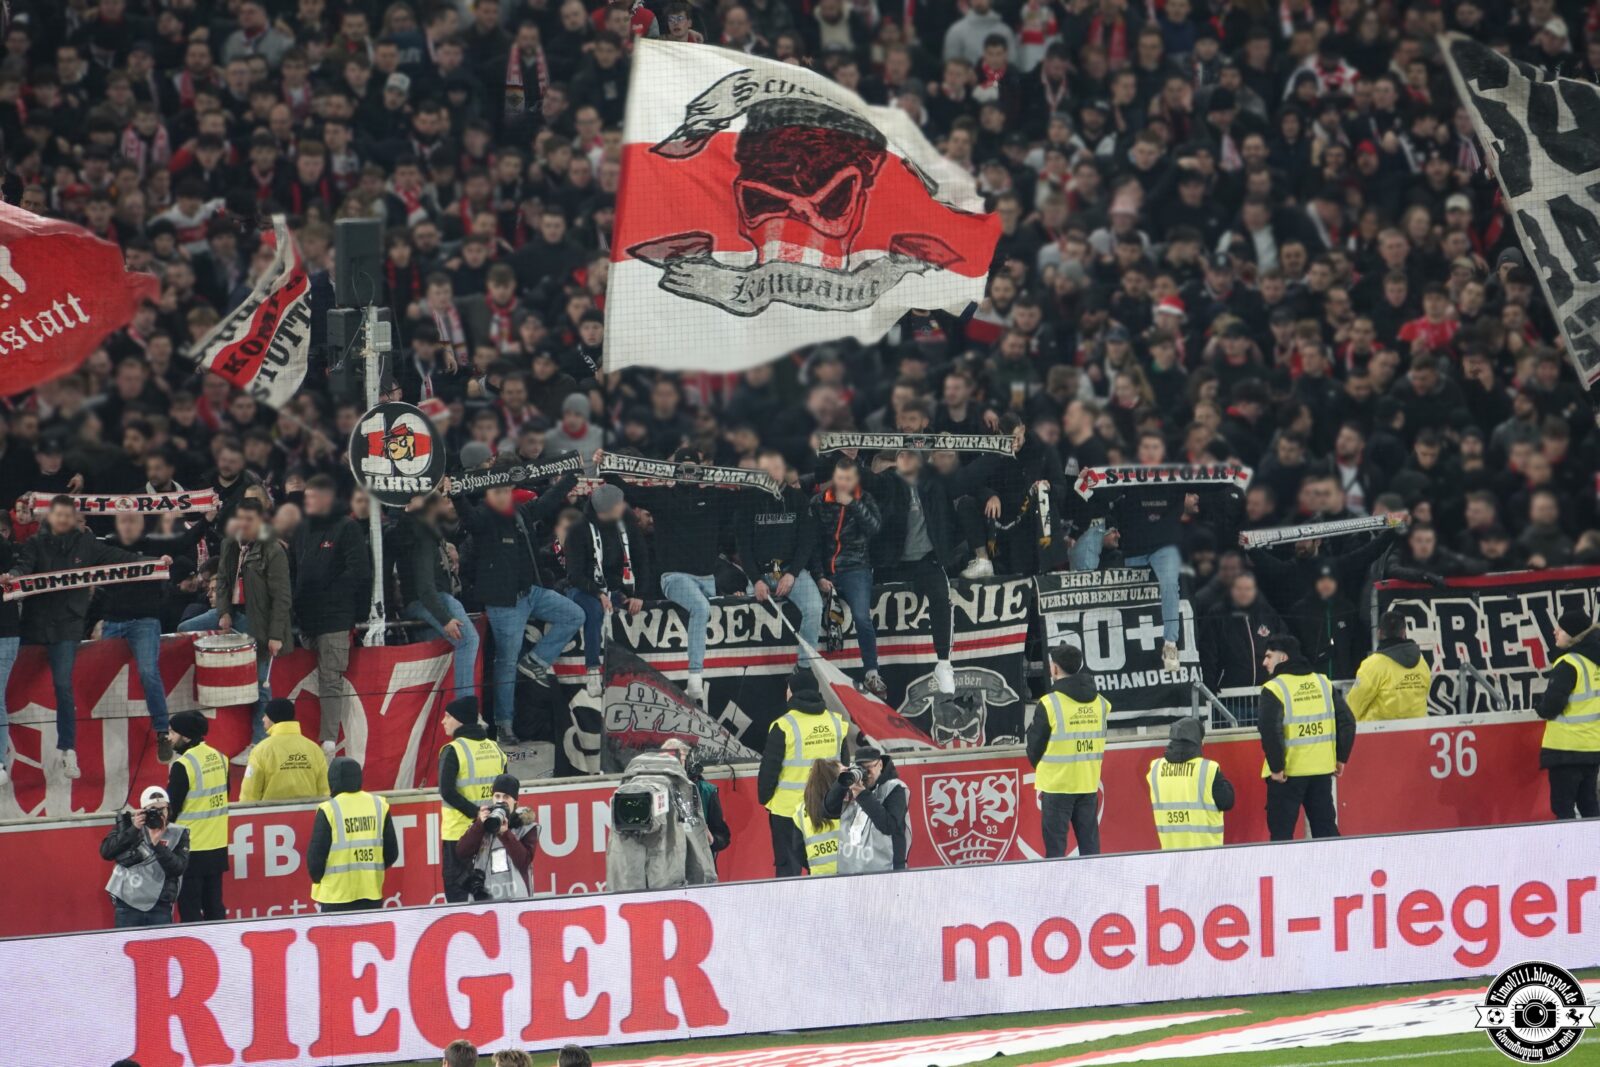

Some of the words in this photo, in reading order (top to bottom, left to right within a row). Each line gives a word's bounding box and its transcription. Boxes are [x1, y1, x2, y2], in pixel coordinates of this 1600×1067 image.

[731, 272, 879, 304] Kompanie
[0, 292, 91, 355] statt
[361, 413, 434, 476] 10
[820, 434, 904, 449] SCHWABEN
[600, 454, 676, 477] SCHWABEN
[1104, 465, 1243, 484] STUTTGART
[364, 475, 433, 492] JAHRE
[19, 563, 155, 593] COMMANDO
[1060, 572, 1101, 588] EHRE
[1103, 568, 1152, 585] ALLEN
[1040, 589, 1128, 609] VERSTORBENEN
[1130, 586, 1162, 600] ULTR
[1044, 598, 1200, 673] 50+1
[1094, 665, 1203, 692] RHANDELBA
[1298, 722, 1324, 737] 2495
[1429, 730, 1478, 779] 36
[1160, 761, 1196, 777] SECURITY
[344, 814, 377, 834] SECURITY
[1167, 810, 1191, 824] 3591
[947, 828, 959, 838] 18
[985, 825, 998, 836] 93
[227, 822, 301, 880] fB
[353, 848, 374, 862] 1385
[813, 840, 838, 857] 3683
[941, 868, 1598, 969] moebel-rieger
[123, 898, 730, 1067] RIEGER
